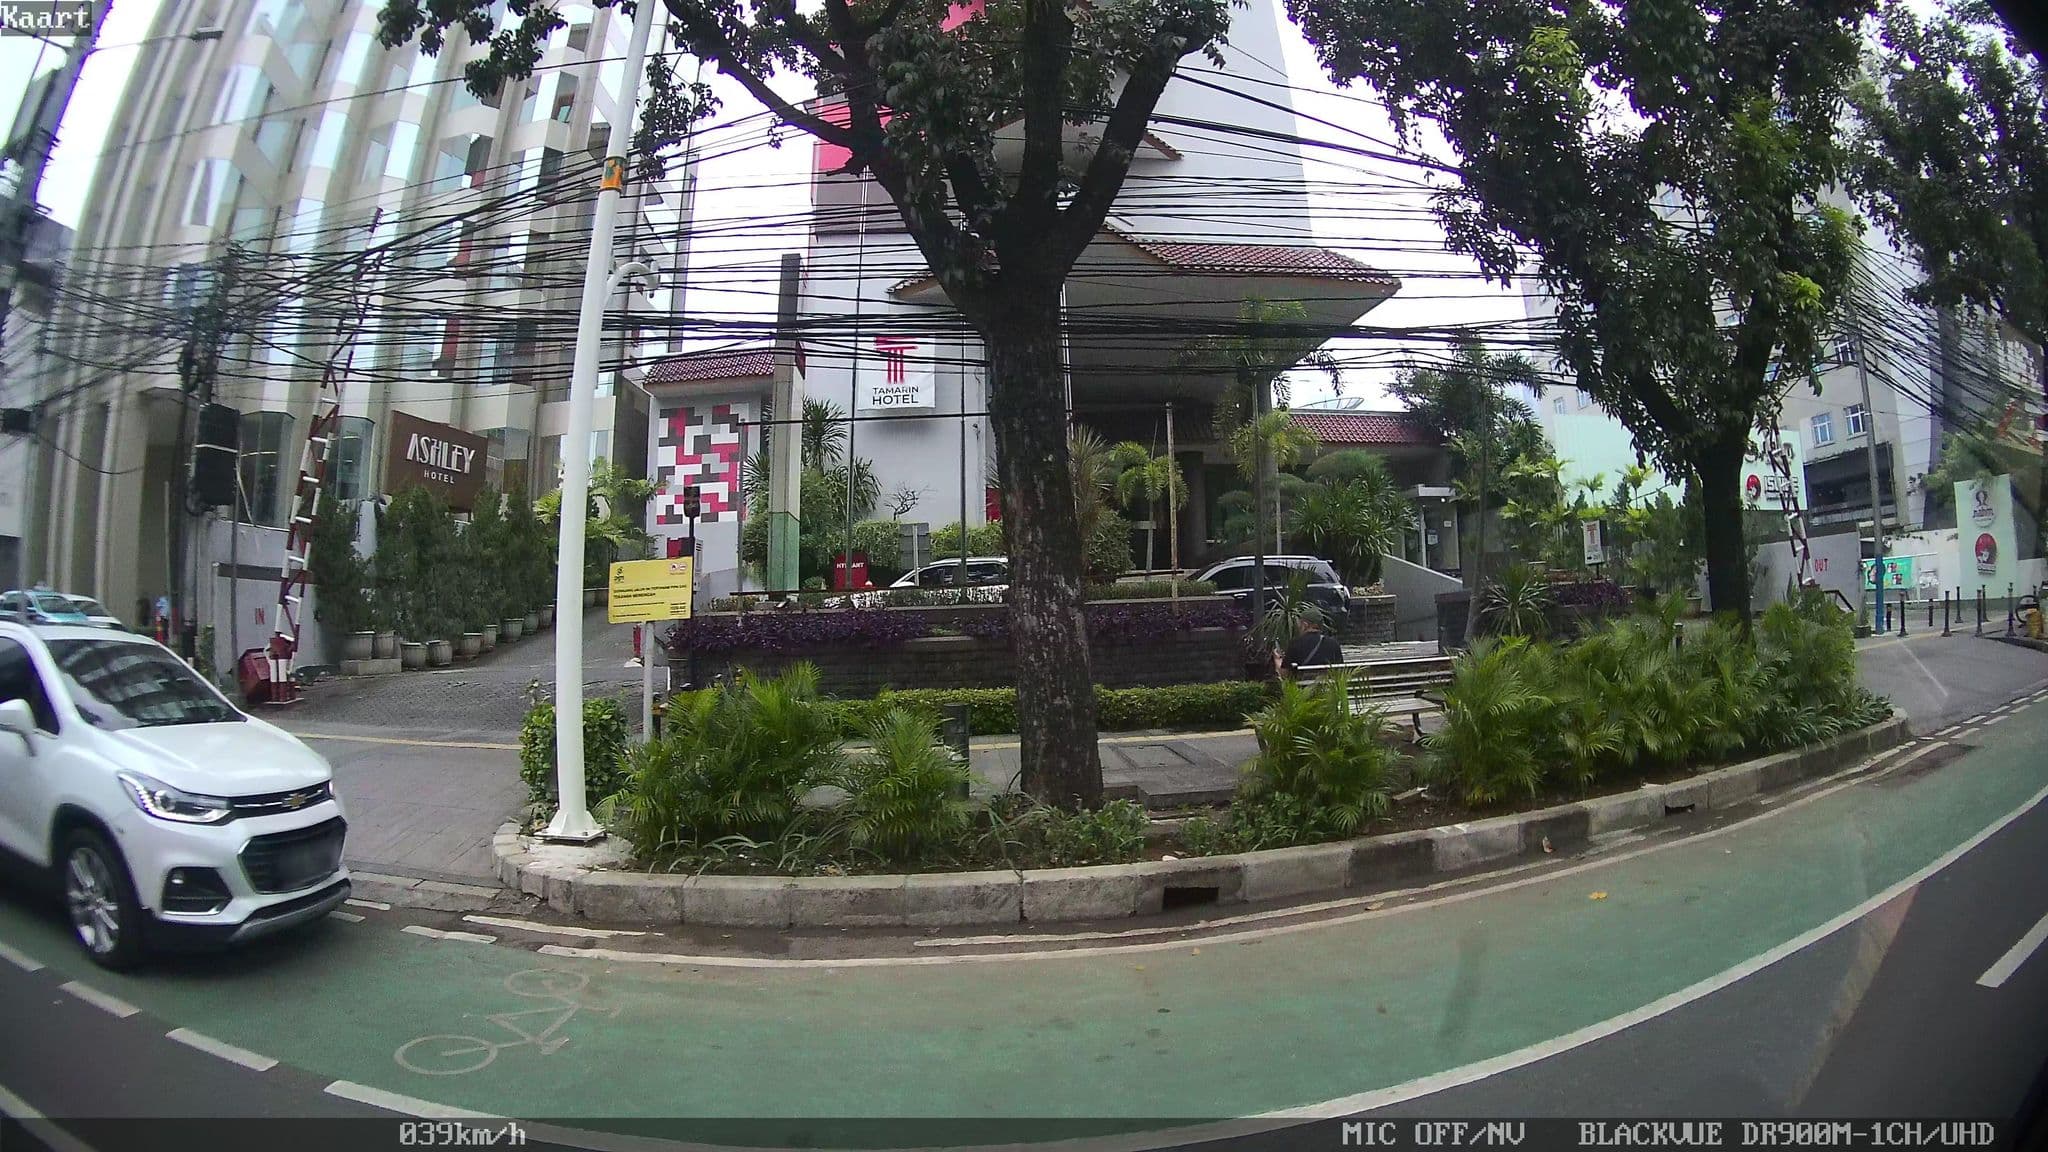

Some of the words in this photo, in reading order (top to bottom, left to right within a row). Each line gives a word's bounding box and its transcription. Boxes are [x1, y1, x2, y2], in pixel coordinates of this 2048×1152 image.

[872, 386, 919, 395] TAMARIN
[872, 394, 919, 405] HOTEL
[406, 433, 475, 473] ASHLEY
[424, 470, 455, 484] HOTEL
[1815, 558, 1828, 572] OUT
[255, 607, 265, 625] IN
